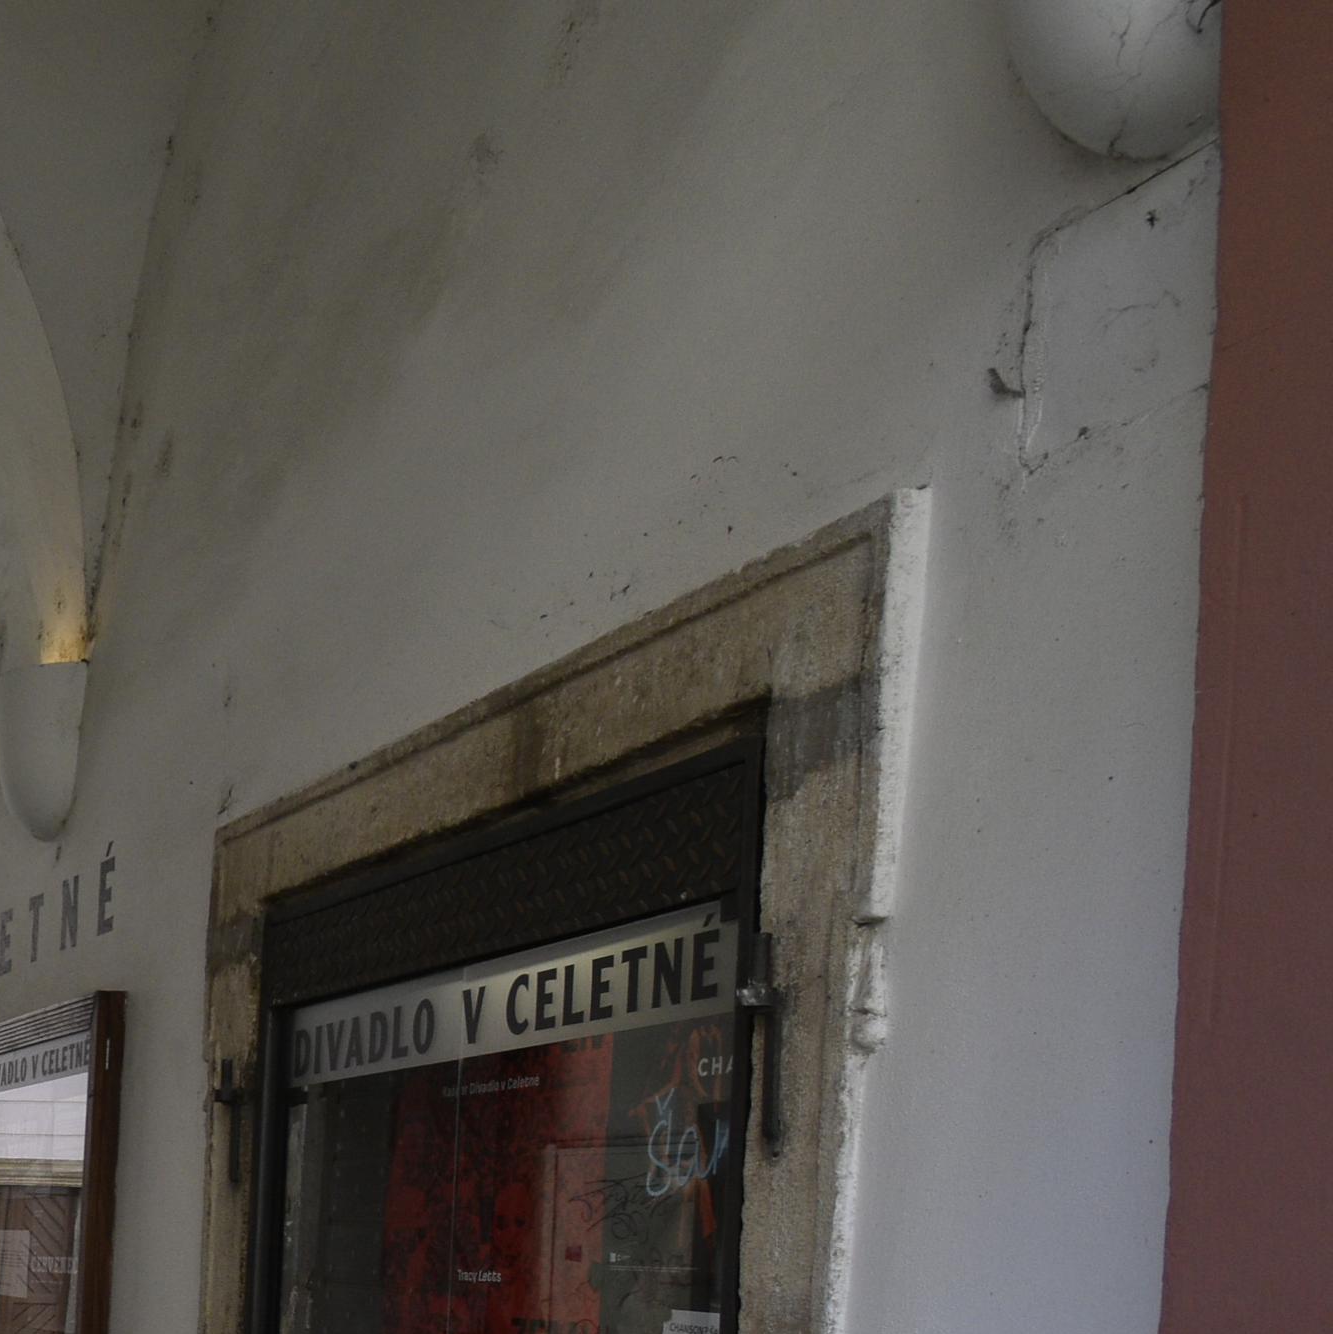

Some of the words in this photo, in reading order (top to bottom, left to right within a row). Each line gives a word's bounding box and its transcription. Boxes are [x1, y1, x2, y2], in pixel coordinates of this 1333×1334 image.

[294, 998, 435, 1080] DIVADLO
[463, 985, 486, 1044] V
[505, 914, 720, 1036] CELETNÉ
[32, 1053, 39, 1079] V
[457, 1269, 477, 1283] Tracy
[478, 1269, 501, 1283] Letts
